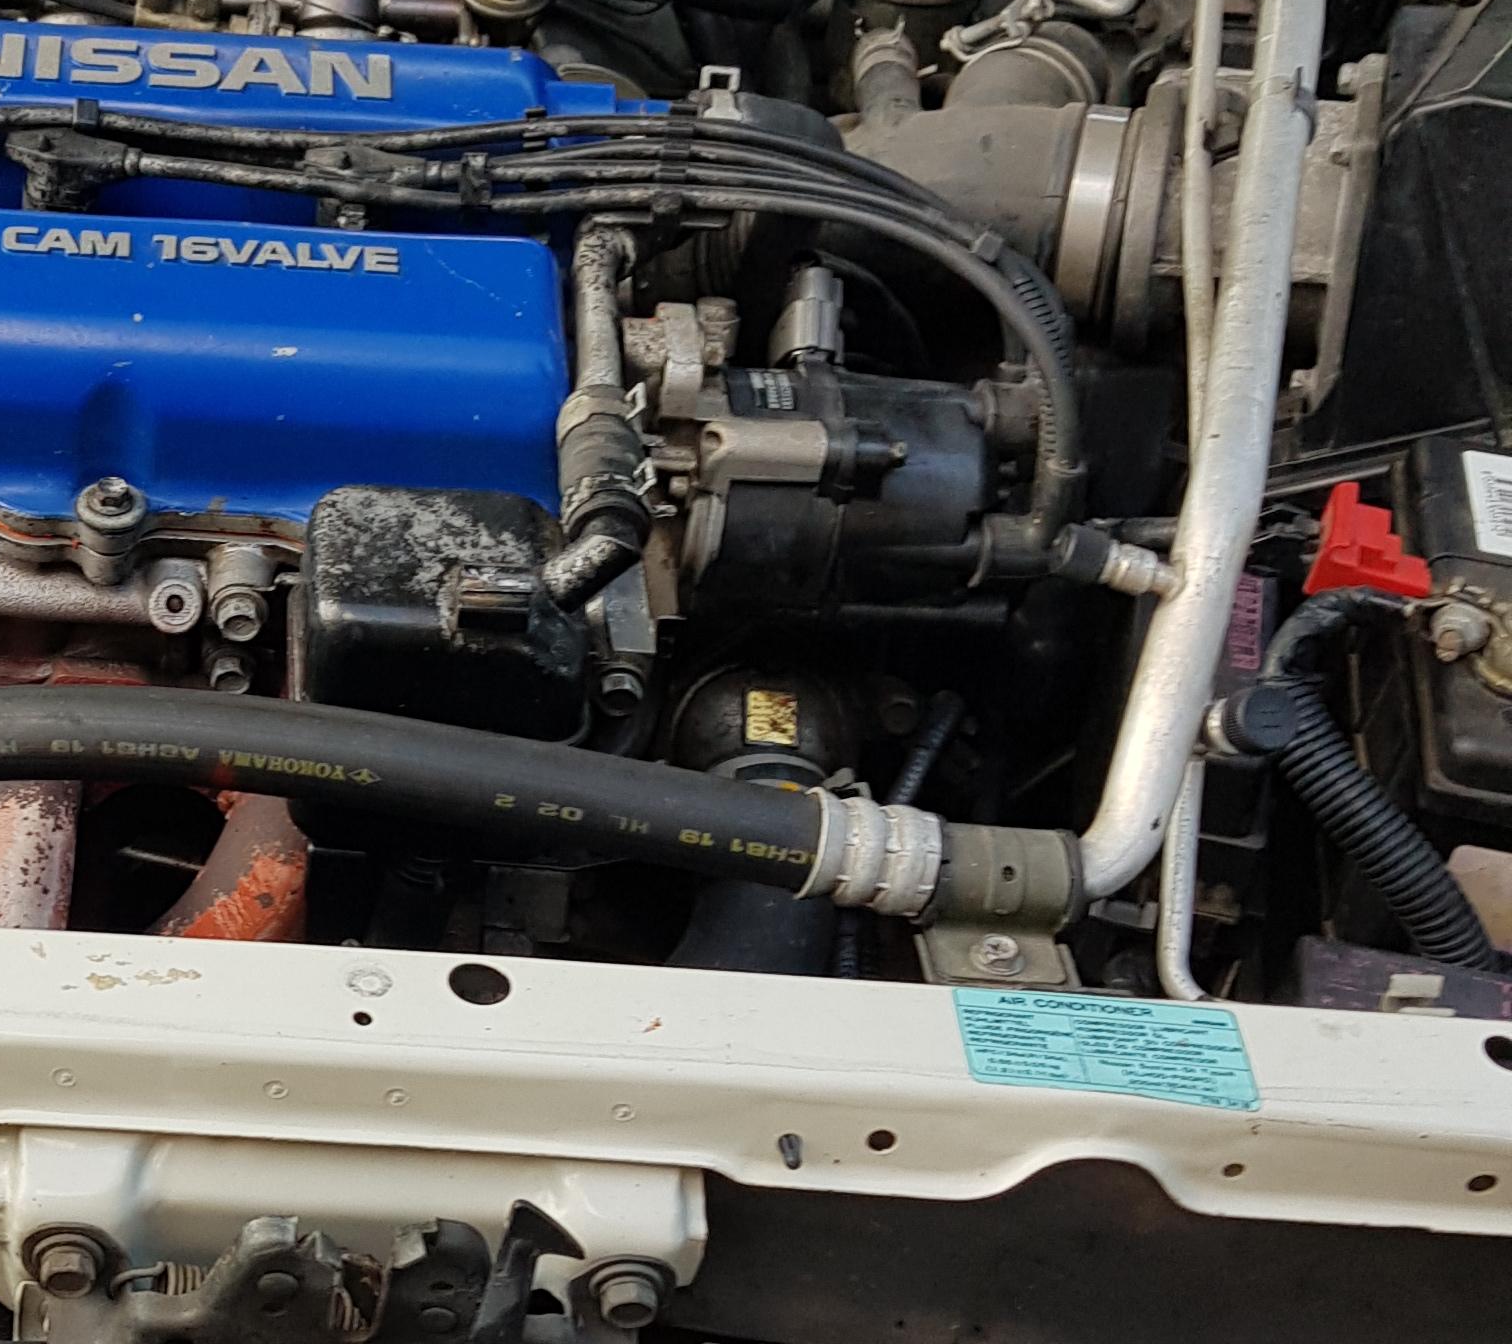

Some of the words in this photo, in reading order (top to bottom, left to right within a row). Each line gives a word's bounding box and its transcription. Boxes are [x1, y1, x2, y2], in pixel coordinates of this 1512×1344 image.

[3, 225, 131, 258] CAM
[153, 234, 400, 275] 16VALVE
[218, 749, 346, 781] YOKOHAMA
[998, 996, 1027, 1006] AIR
[1033, 999, 1155, 1017] CONDITIONER
